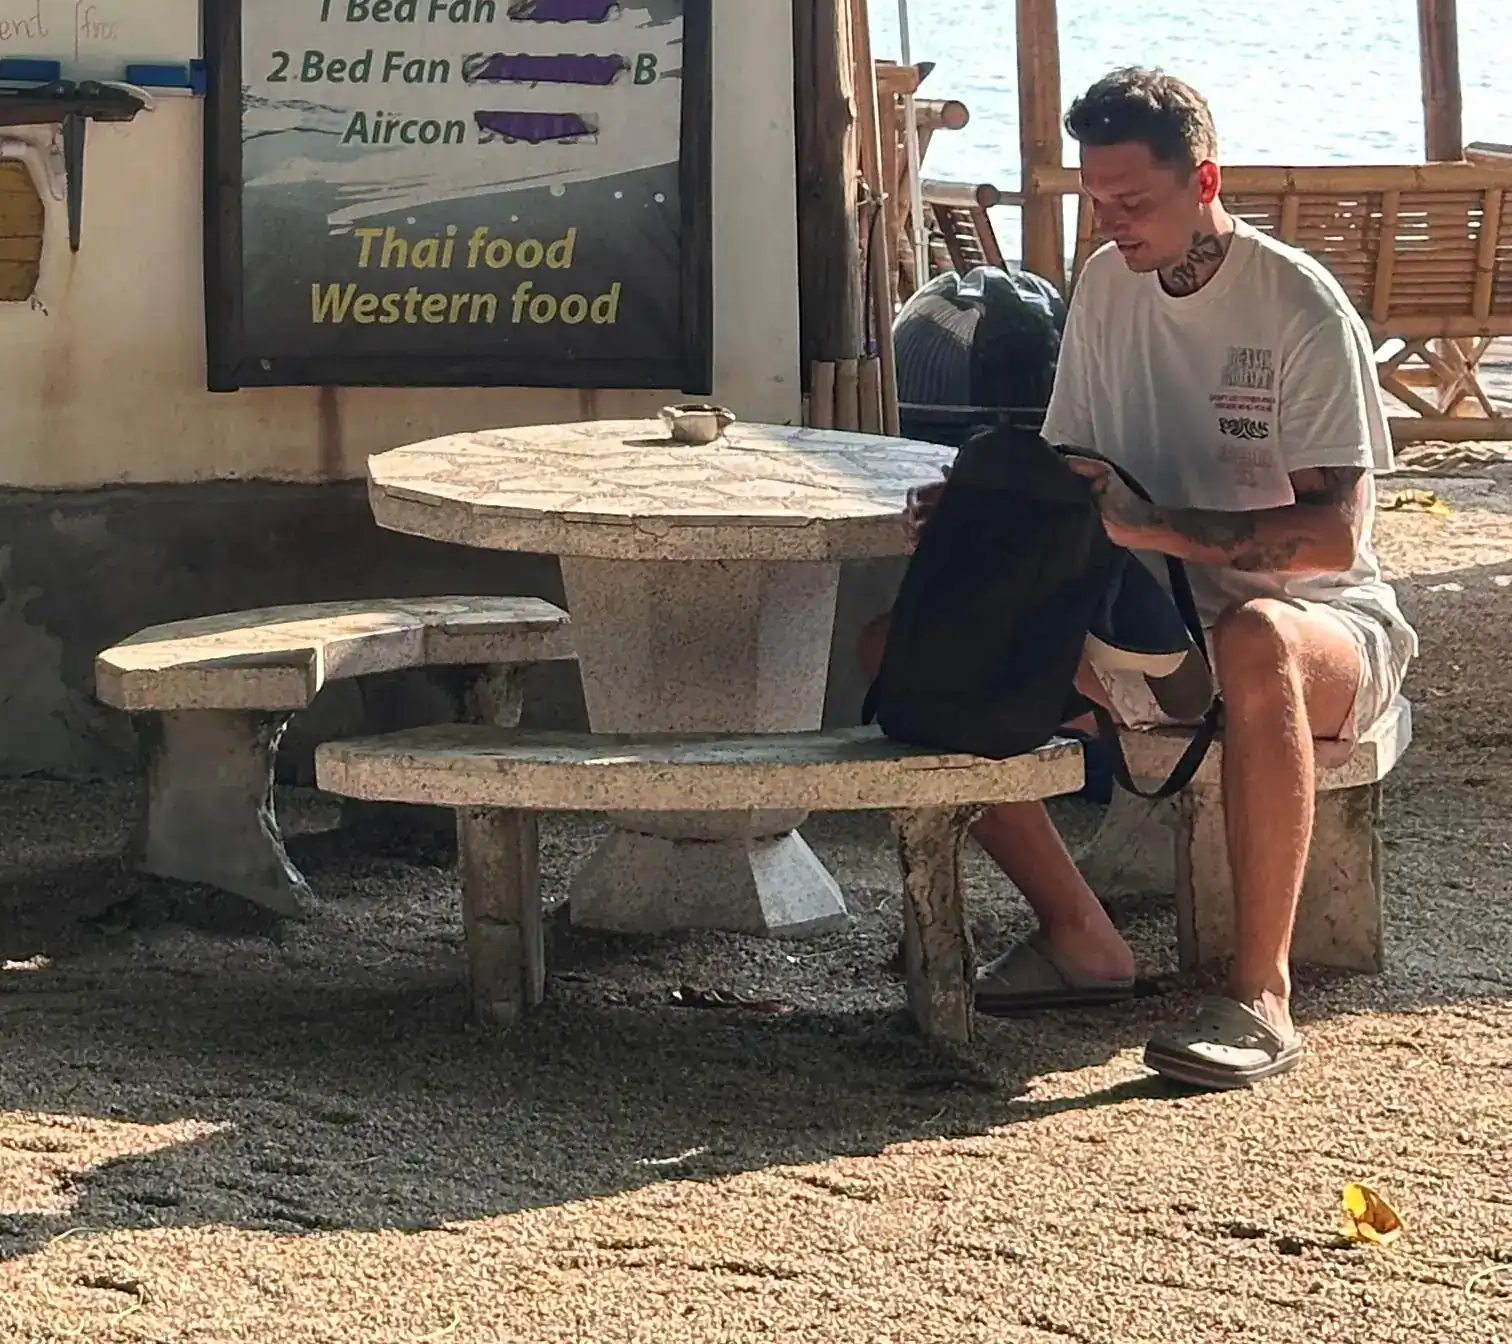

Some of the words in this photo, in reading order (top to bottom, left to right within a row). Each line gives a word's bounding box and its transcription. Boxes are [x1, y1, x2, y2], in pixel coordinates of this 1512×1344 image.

[267, 50, 290, 83] 2
[300, 50, 377, 83] Bed
[382, 51, 450, 83] Fan
[633, 53, 658, 85] B
[342, 111, 466, 144] Aircon
[354, 227, 456, 269] Thai
[467, 227, 577, 269] food
[310, 281, 497, 324] Western
[510, 281, 622, 324] food
